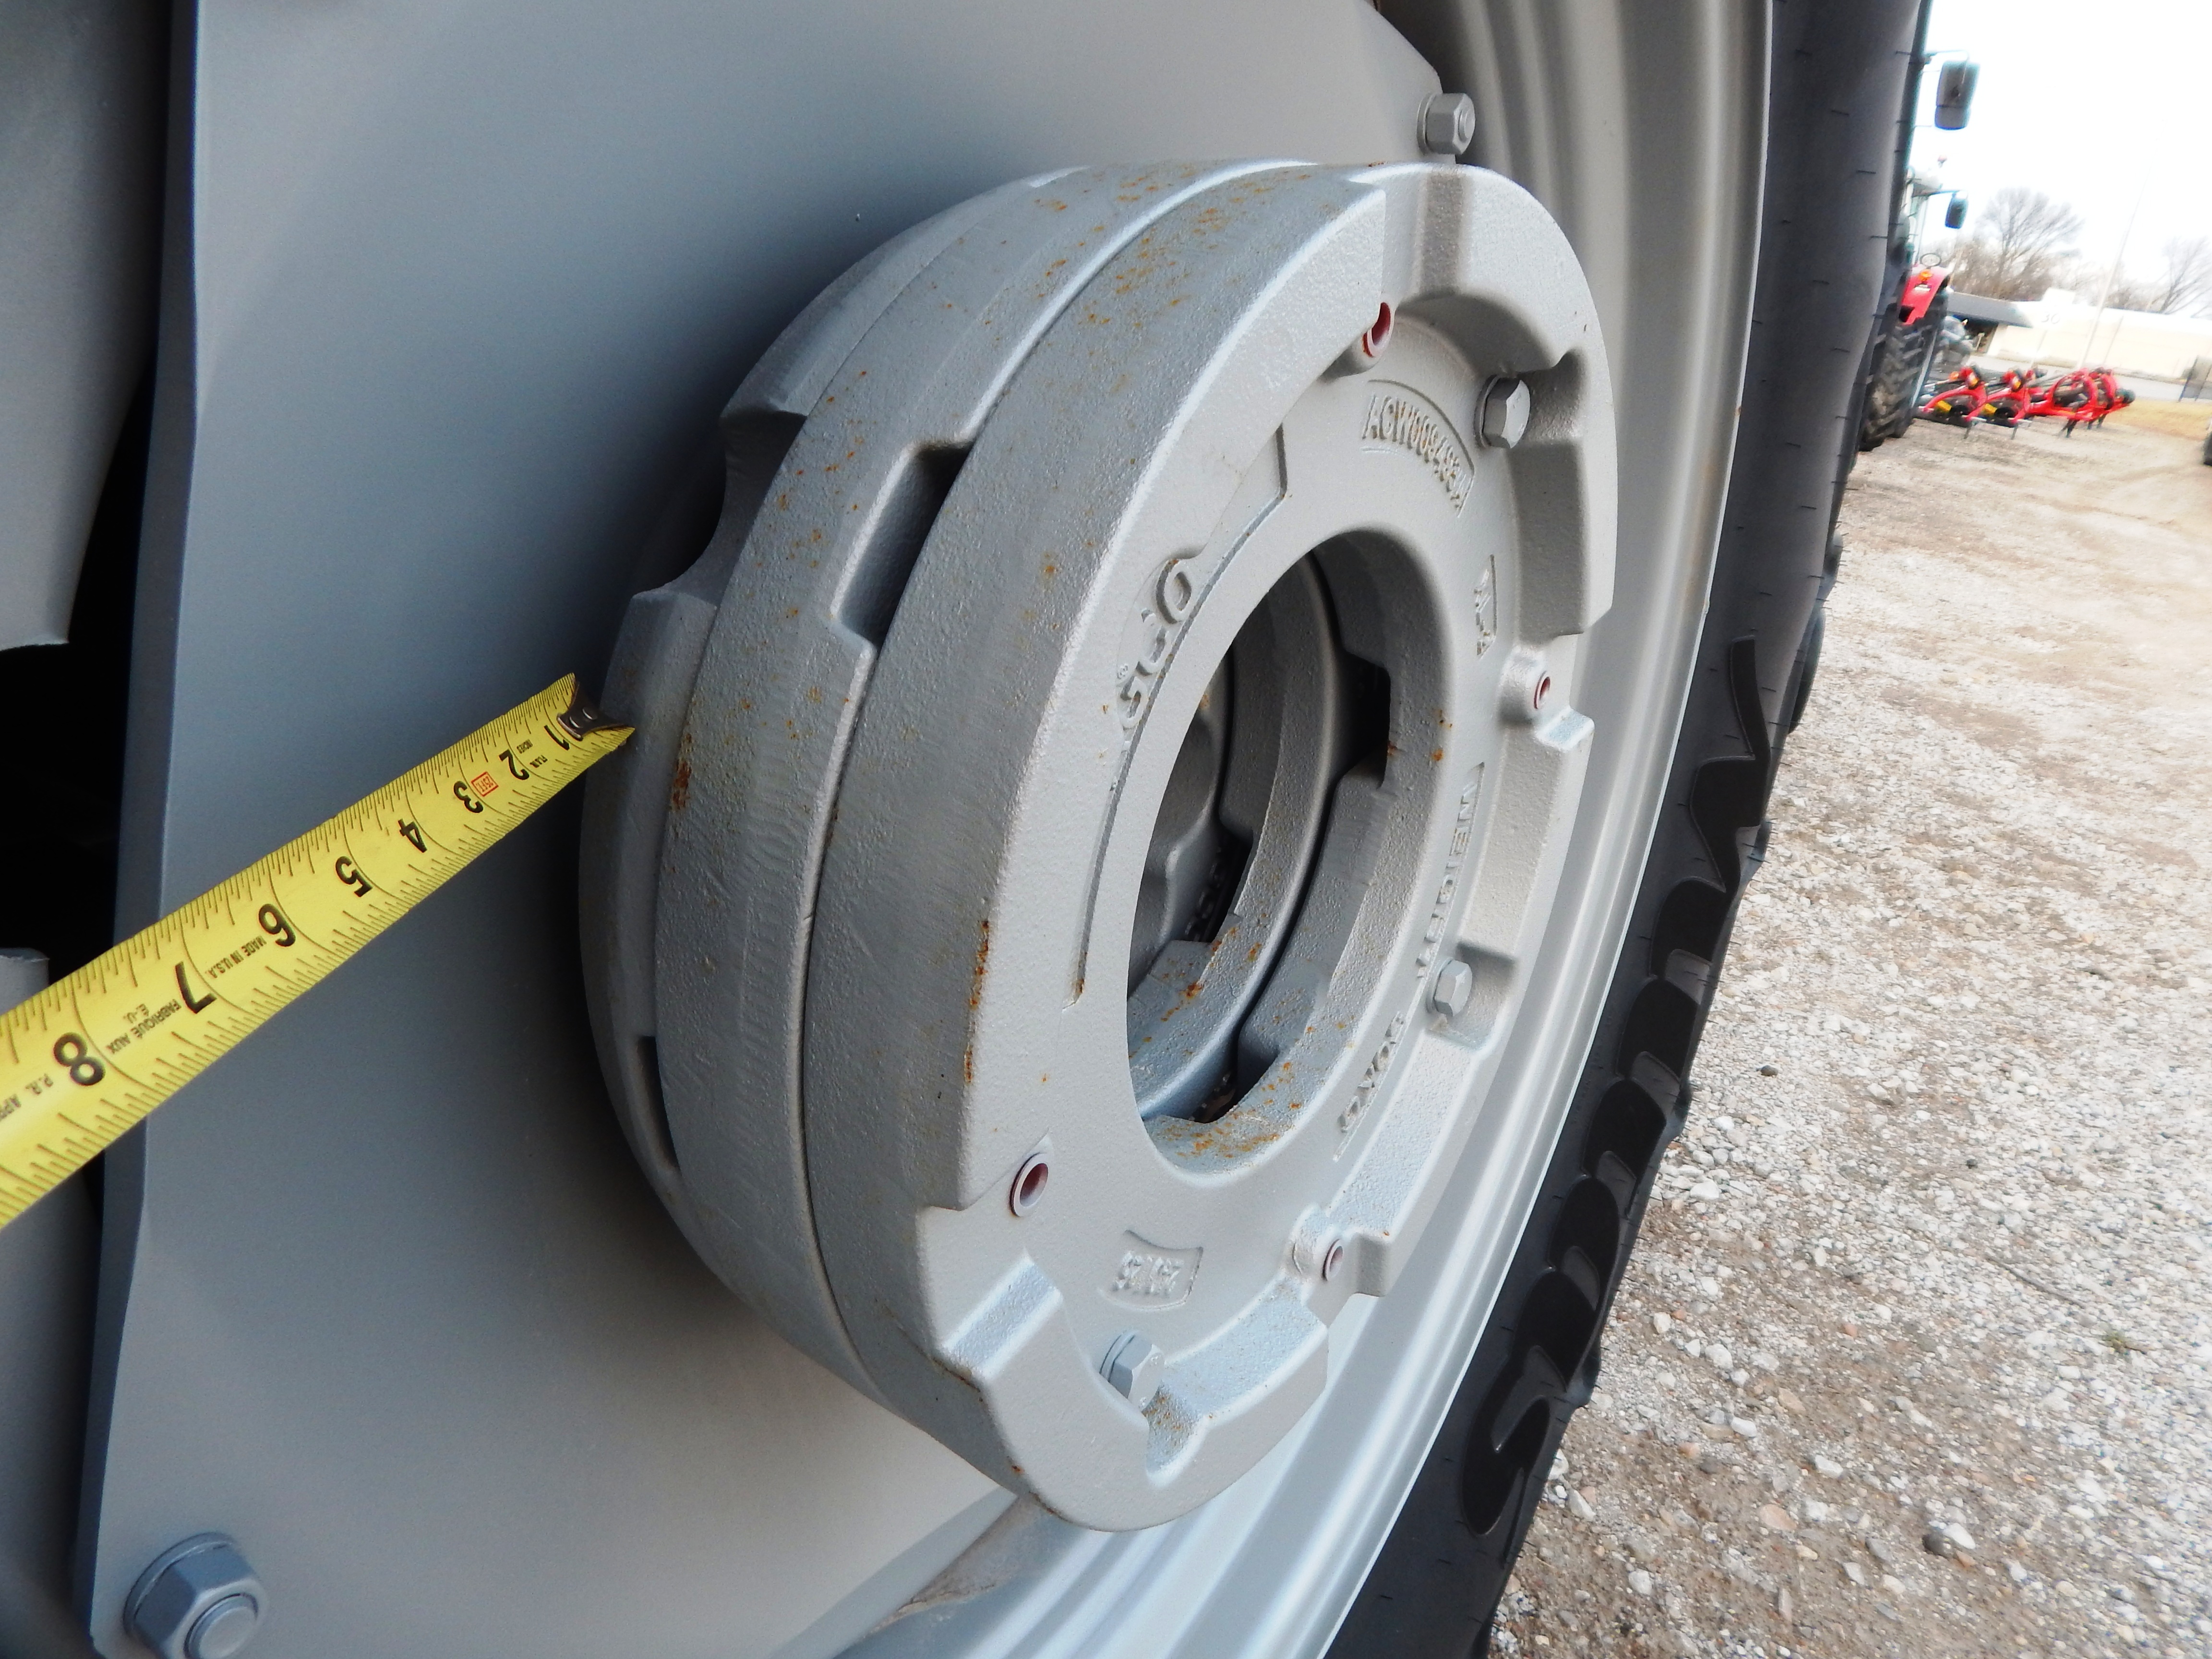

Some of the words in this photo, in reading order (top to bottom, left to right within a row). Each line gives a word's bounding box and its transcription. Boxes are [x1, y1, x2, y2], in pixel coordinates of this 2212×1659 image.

[544, 725, 570, 751] 1
[499, 749, 529, 780] 2
[453, 781, 484, 813] 3
[398, 818, 427, 853] 4
[336, 856, 373, 897] 5
[258, 903, 296, 947] 6
[230, 950, 245, 965] IN
[241, 936, 267, 957] MADE
[205, 957, 234, 978] U.S.A.
[175, 961, 217, 1014] 7
[53, 1032, 106, 1087] 8
[105, 1033, 131, 1055] AUX
